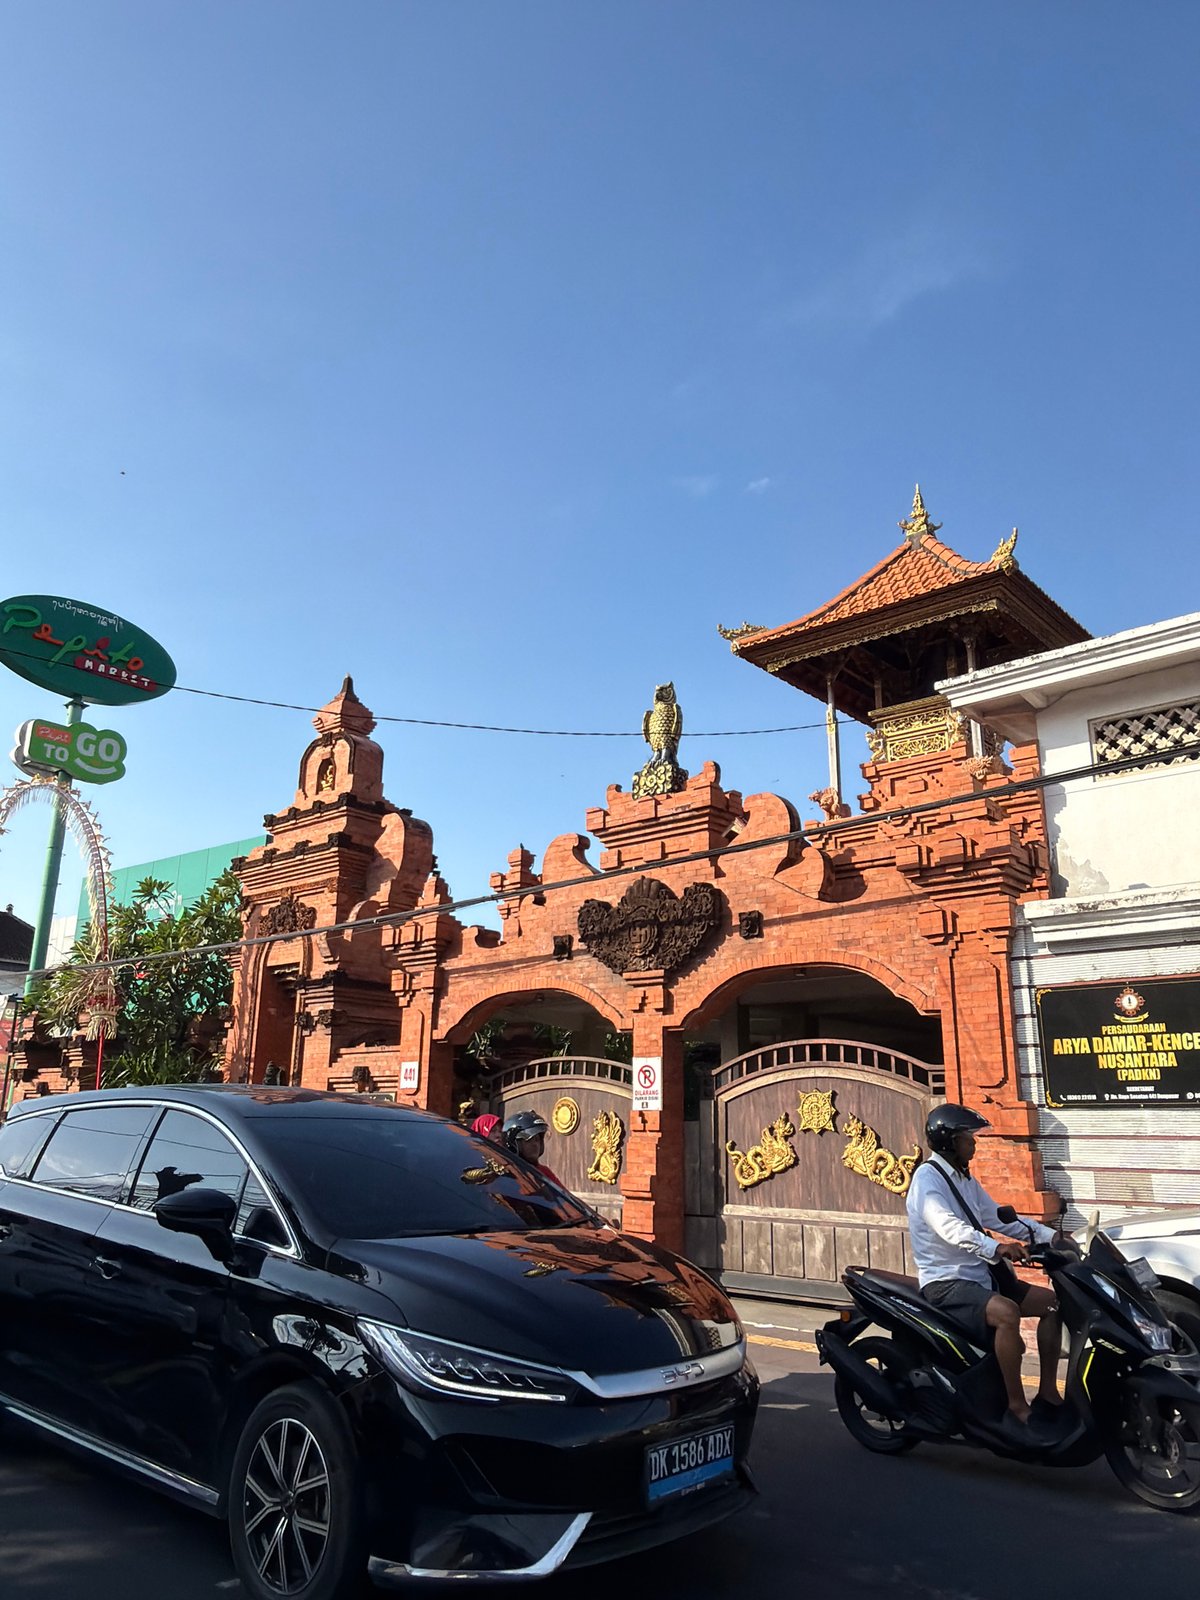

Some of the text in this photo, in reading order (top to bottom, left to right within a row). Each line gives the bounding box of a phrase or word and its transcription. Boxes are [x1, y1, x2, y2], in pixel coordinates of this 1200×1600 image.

[3, 604, 144, 671] Pepito
[85, 659, 151, 687] MARKET
[43, 732, 121, 763] TO GO
[1102, 1023, 1166, 1035] PERSAUDARAAN
[1053, 1038, 1091, 1055] ARYA
[1098, 1052, 1178, 1069] NUSANTARA
[404, 1068, 416, 1081] 441
[1117, 1069, 1161, 1081] (PADKN)
[660, 1362, 705, 1385] BYD
[650, 1429, 733, 1481] DK 1586 ADX
